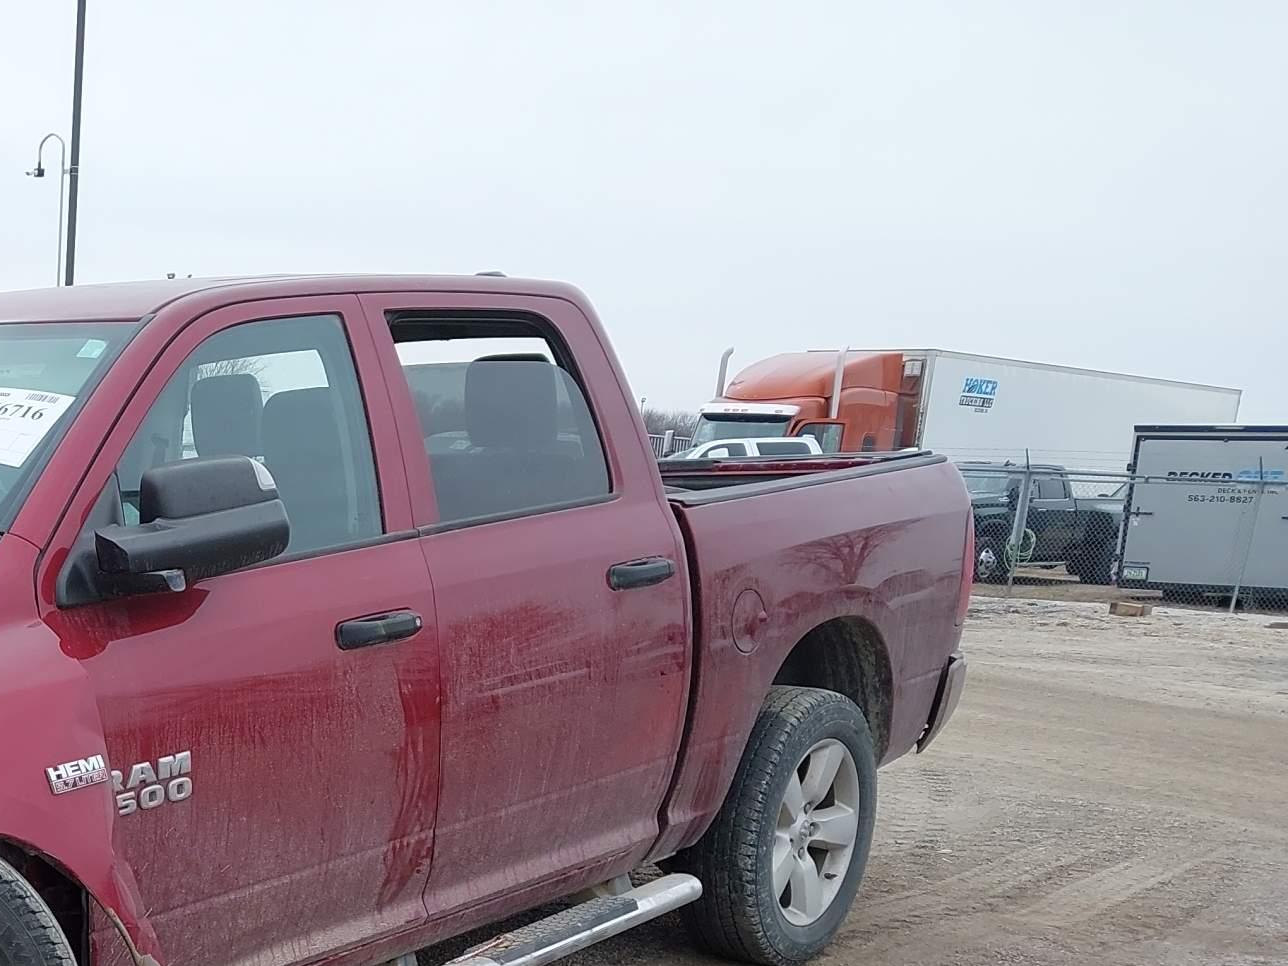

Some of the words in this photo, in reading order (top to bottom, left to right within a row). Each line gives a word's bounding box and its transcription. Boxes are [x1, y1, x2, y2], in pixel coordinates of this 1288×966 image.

[46, 754, 105, 781] HEMI
[111, 751, 191, 791] RAM
[54, 778, 75, 793] 5.7
[116, 772, 192, 816] 500
